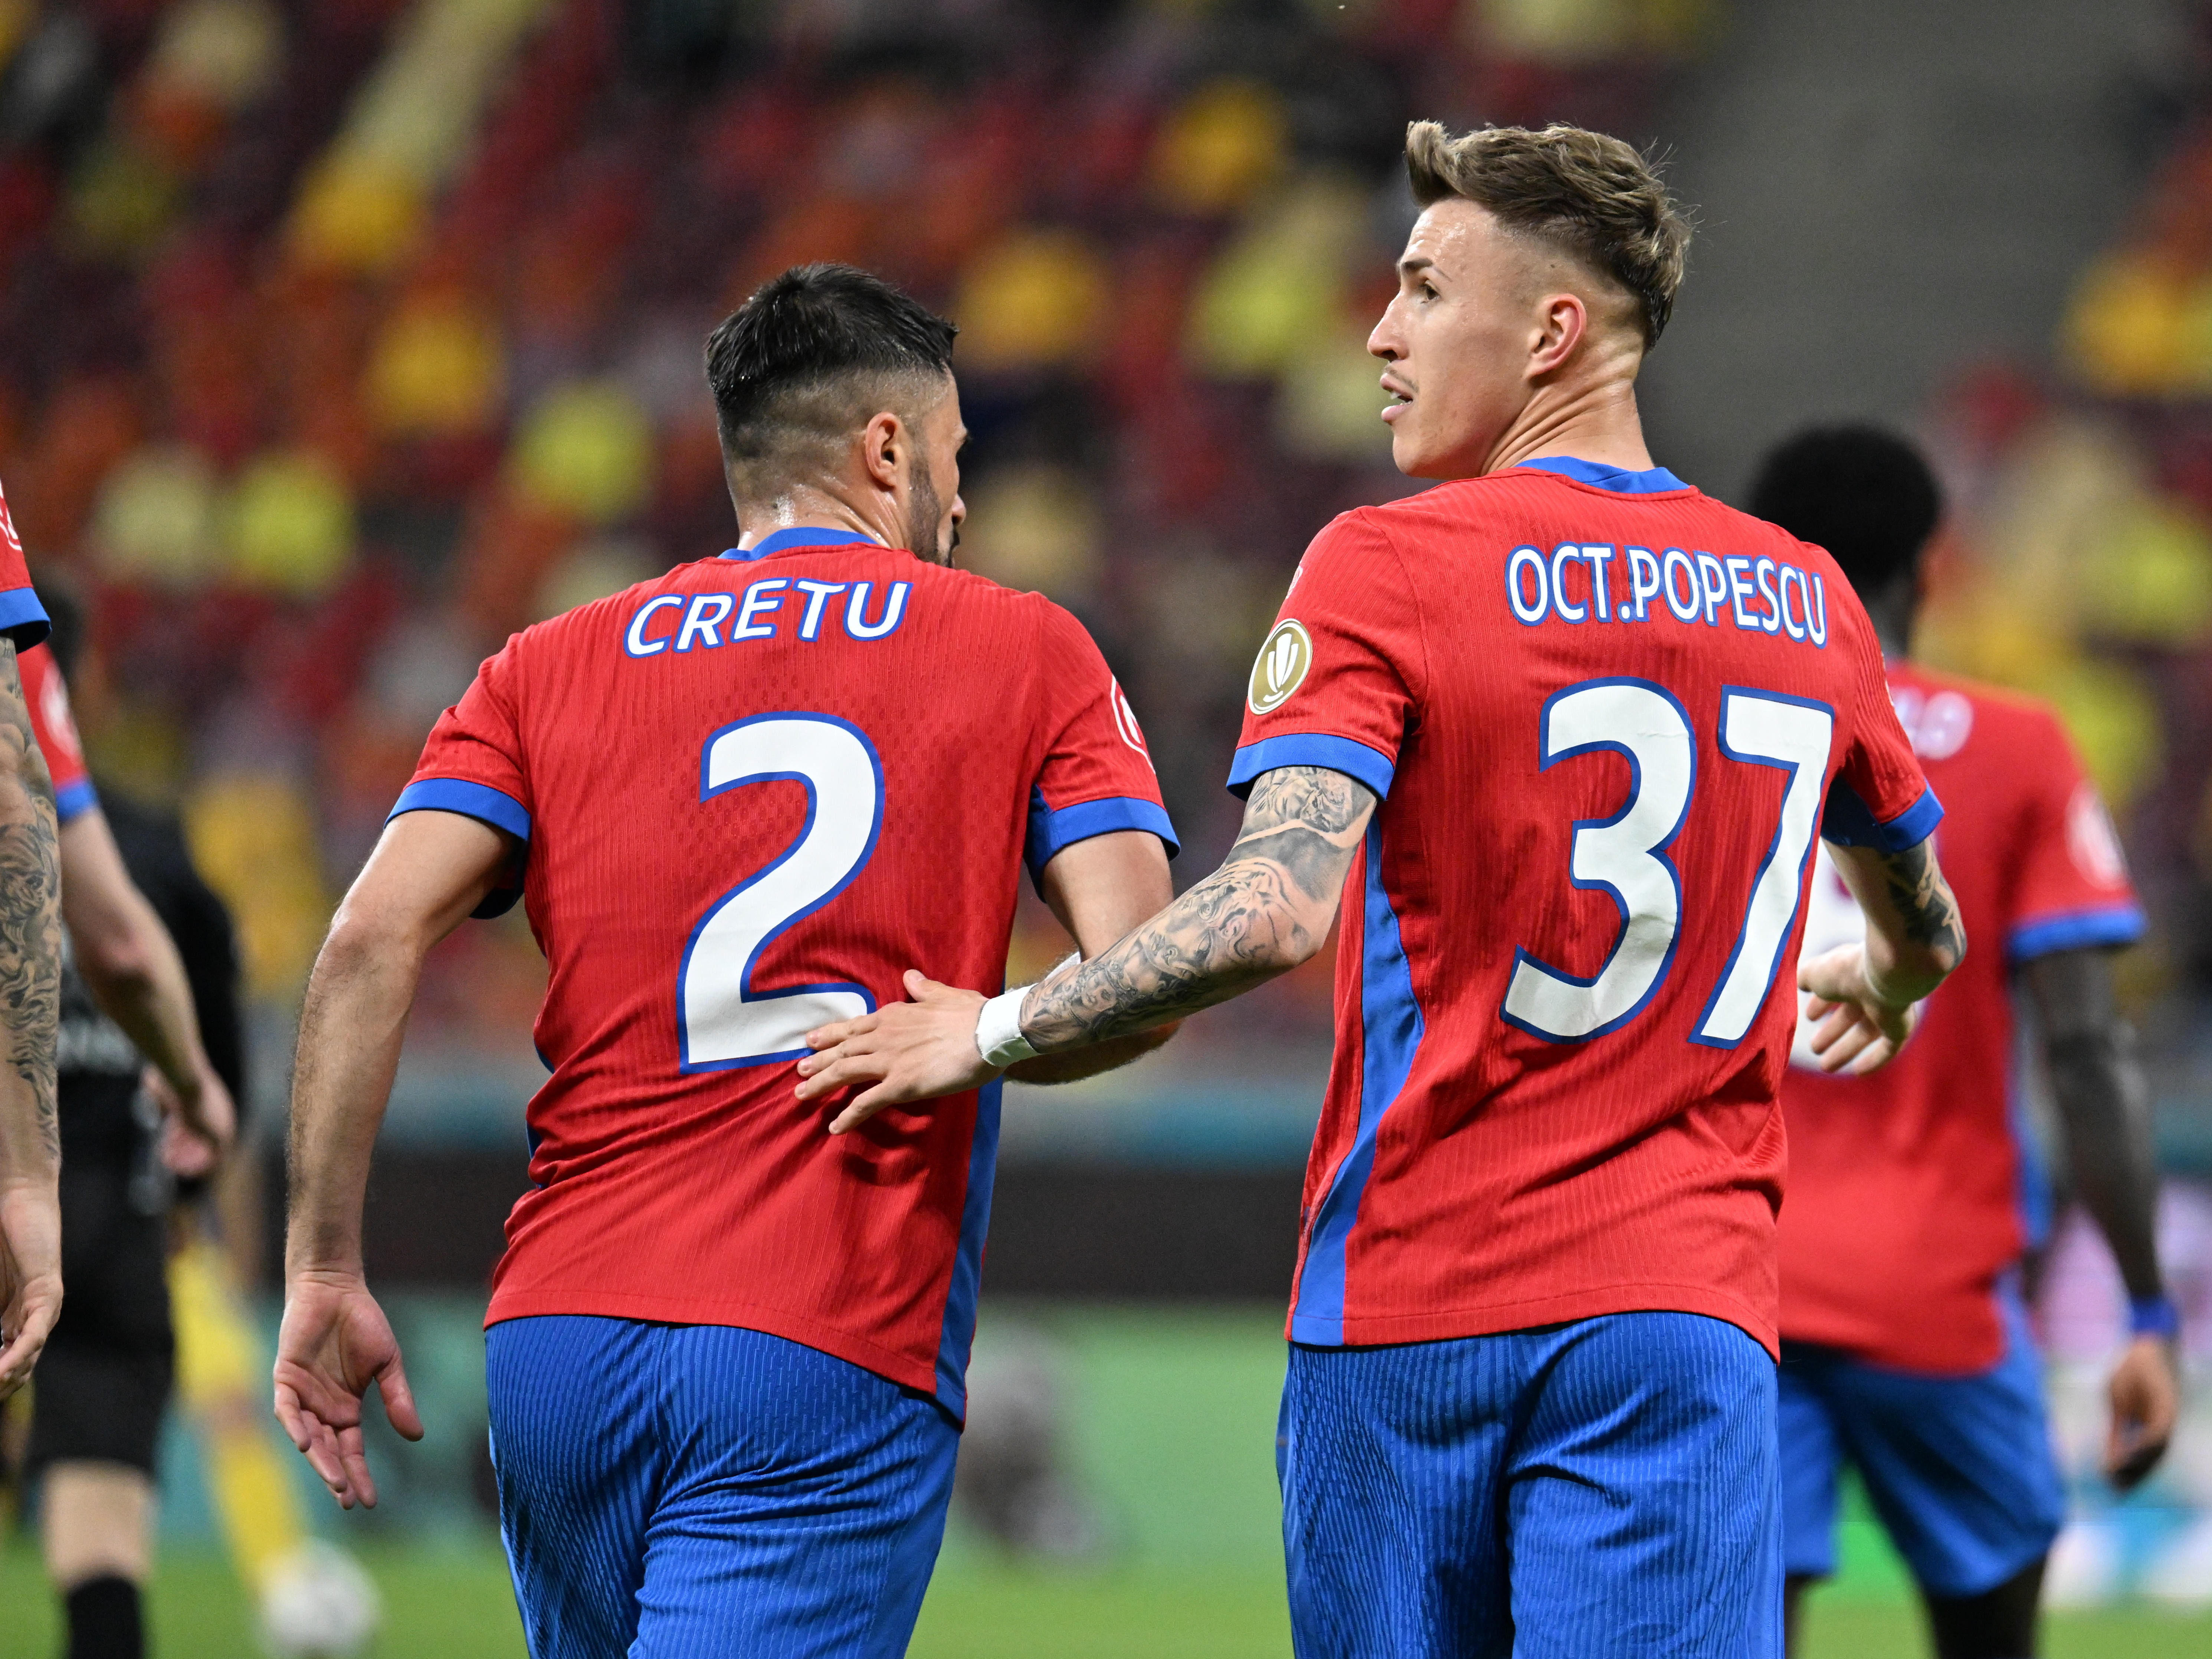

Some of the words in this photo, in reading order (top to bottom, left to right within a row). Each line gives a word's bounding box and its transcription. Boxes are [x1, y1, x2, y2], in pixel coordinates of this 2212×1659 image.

[623, 577, 914, 659] CRETU
[1505, 541, 1827, 649] OCT.POPESCU
[677, 711, 885, 1074] 2
[1500, 676, 1834, 1049] 37
